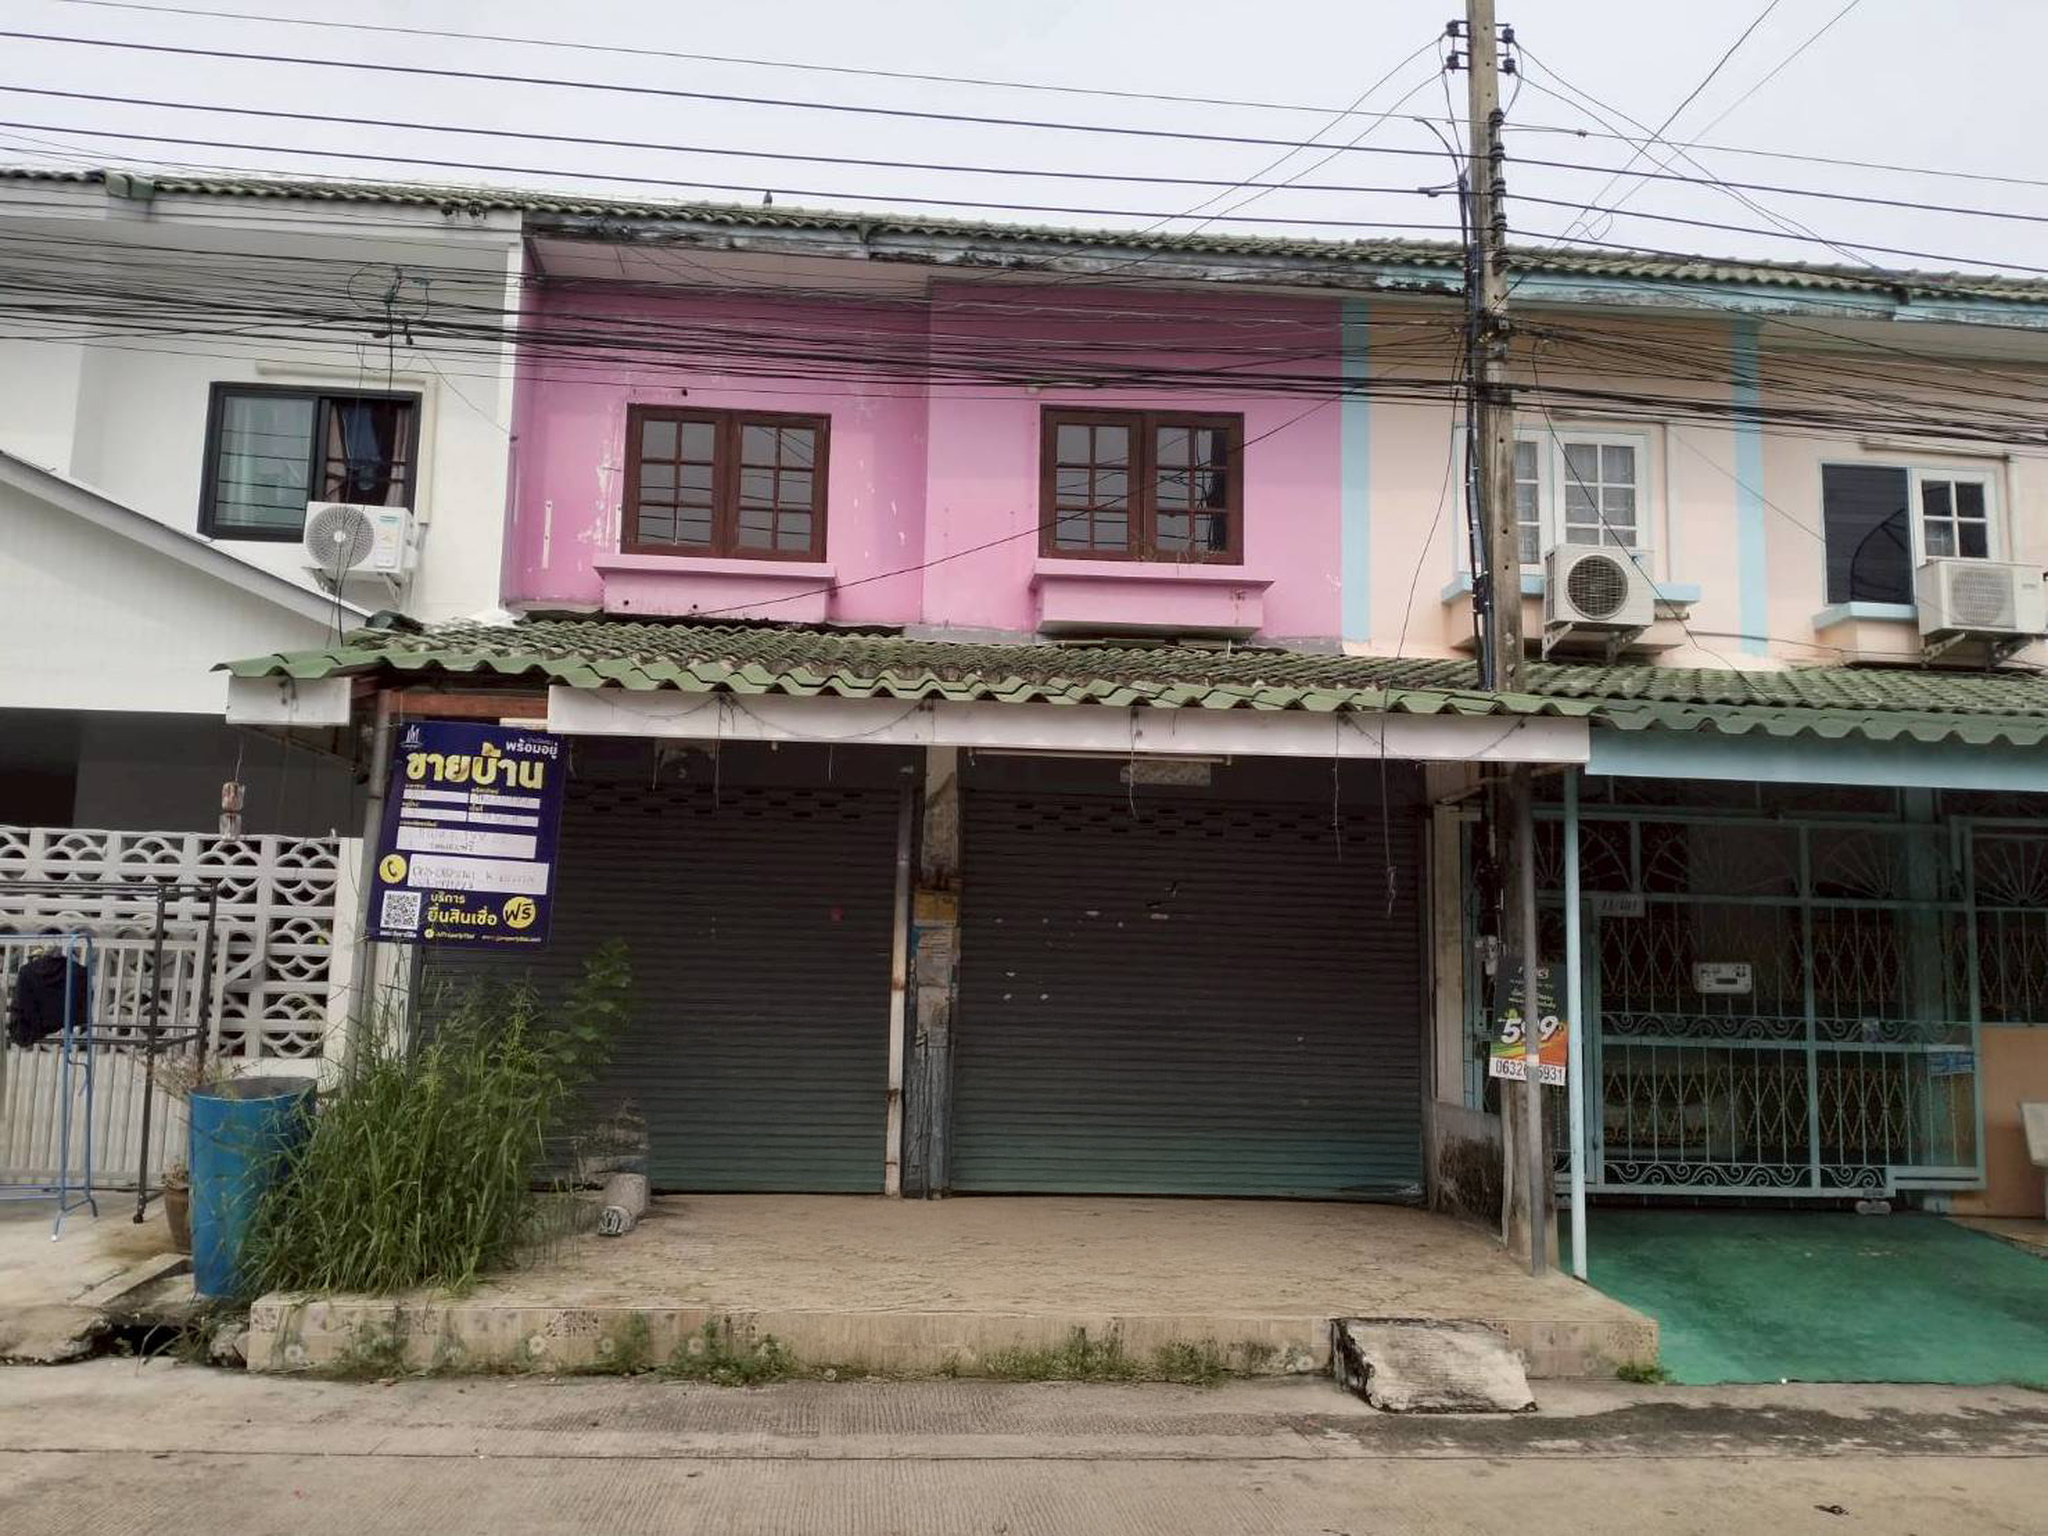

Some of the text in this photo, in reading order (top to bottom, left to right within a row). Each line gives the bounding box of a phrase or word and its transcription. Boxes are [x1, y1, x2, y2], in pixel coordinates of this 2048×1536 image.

[505, 737, 558, 759] พร้อมอยู่
[406, 742, 545, 789] ขายบ้าน
[430, 890, 466, 904] บริการ
[427, 903, 497, 926] ยื่นสินเชื่อ
